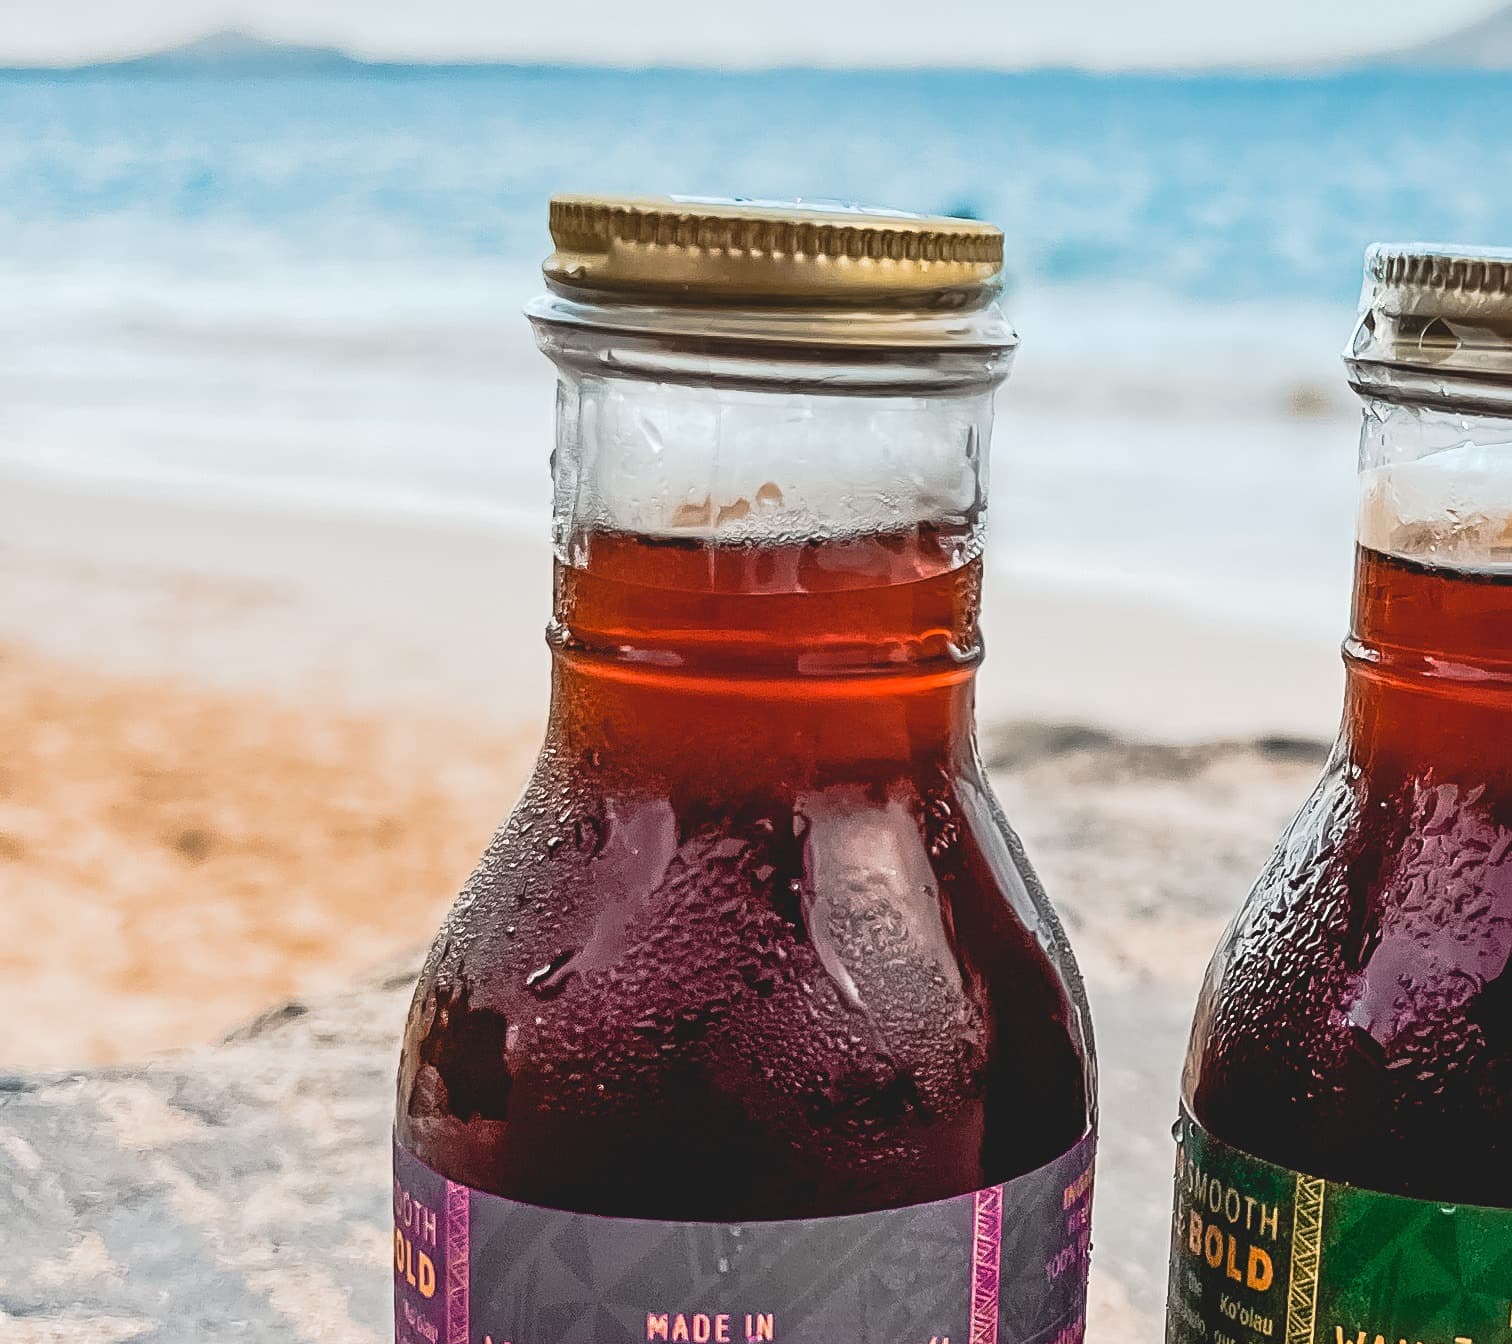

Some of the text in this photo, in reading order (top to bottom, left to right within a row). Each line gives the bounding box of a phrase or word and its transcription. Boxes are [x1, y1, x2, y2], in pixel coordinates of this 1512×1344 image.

[1188, 1208, 1274, 1292] BOLD
[647, 1312, 775, 1344] MADE IN
